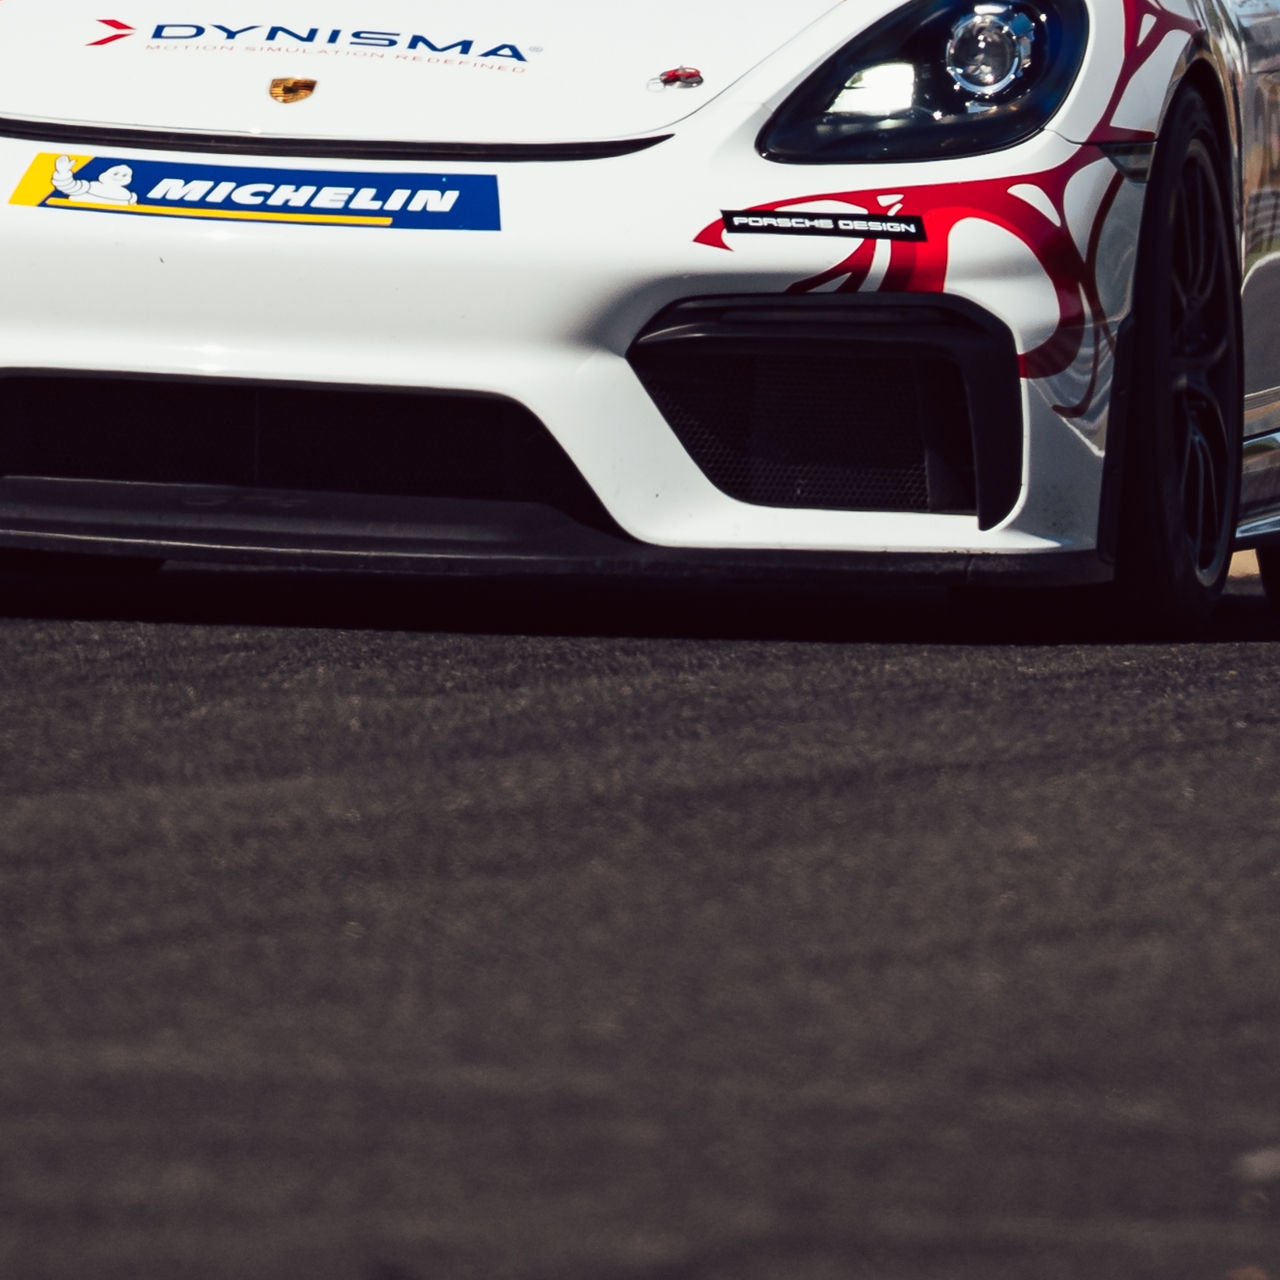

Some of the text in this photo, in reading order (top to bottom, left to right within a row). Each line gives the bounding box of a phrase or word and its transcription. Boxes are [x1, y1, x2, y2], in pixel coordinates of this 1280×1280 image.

[145, 44, 526, 73] MOTION SIMULATION REDEFINED
[151, 24, 527, 62] DYNISMA
[147, 178, 461, 213] MICHELIN
[733, 217, 917, 233] PORSCHE DESIGN
